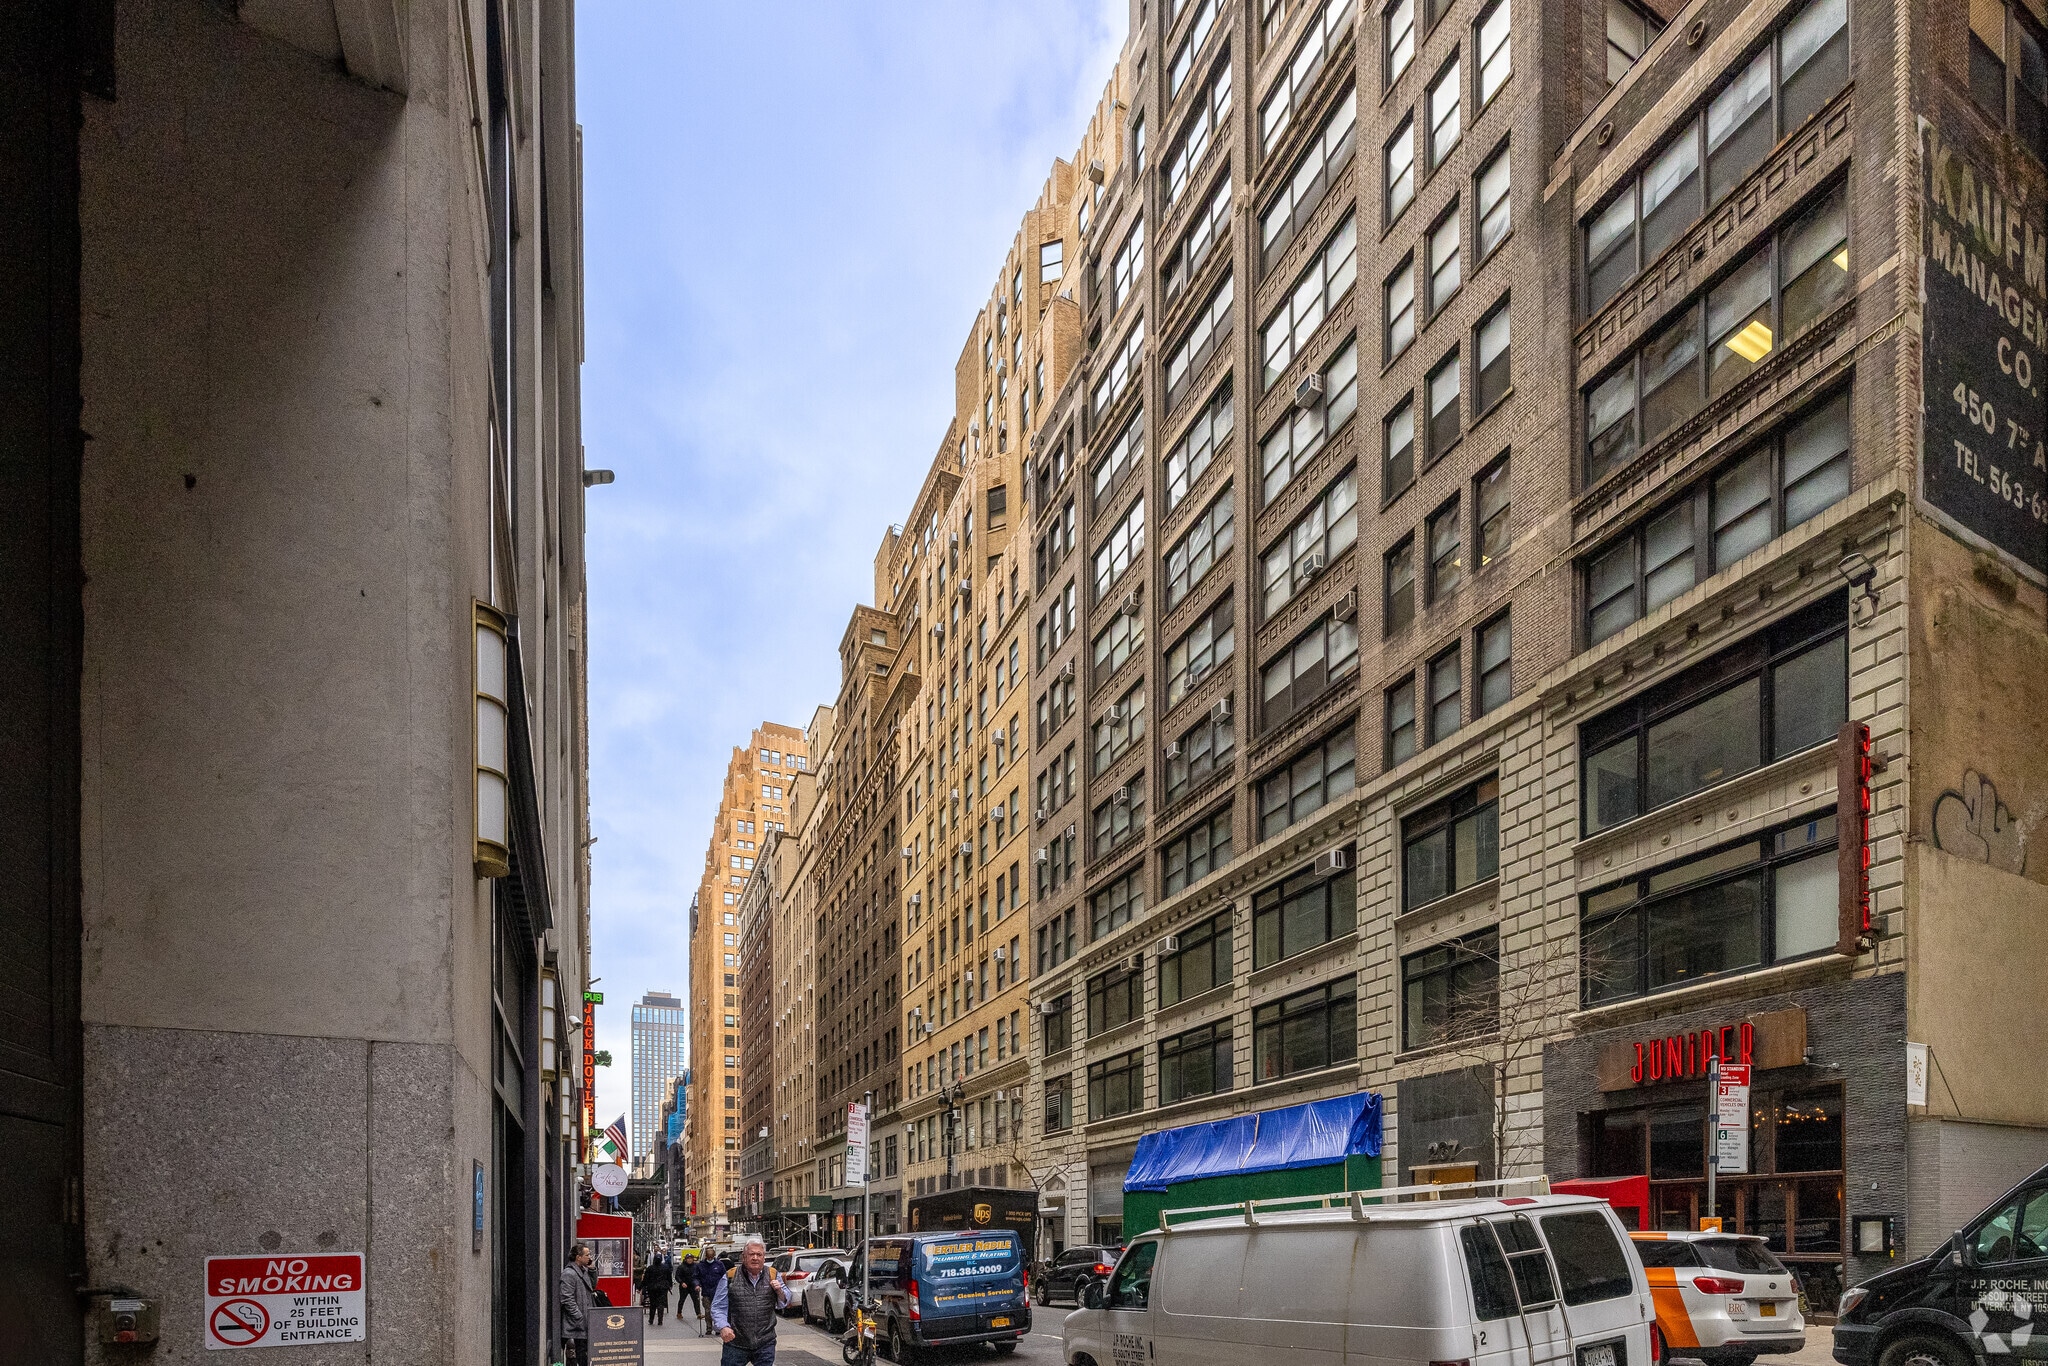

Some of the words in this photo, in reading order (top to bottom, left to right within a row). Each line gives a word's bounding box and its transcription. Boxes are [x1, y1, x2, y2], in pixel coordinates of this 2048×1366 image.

[1997, 336, 2038, 398] CO.
[1952, 381, 1996, 435] 450
[1953, 438, 1985, 485] TEL.
[583, 992, 603, 1003] PUB
[584, 1003, 594, 1050] JACK
[1721, 1086, 1727, 1095] 3
[849, 1104, 854, 1113] 3
[1720, 1131, 1726, 1139] 6
[848, 1146, 853, 1155] 6
[975, 1209, 990, 1221] ups
[932, 1254, 970, 1262] PLUMBING
[971, 1252, 978, 1260] &
[265, 1259, 309, 1276] NO
[218, 1274, 353, 1294] SMOKING
[1971, 1280, 1988, 1289] J.P.
[1990, 1280, 2031, 1291] ROCHE,
[293, 1295, 339, 1306] WITHIN
[957, 1291, 986, 1299] Cleaning
[1978, 1291, 1987, 1301] 55
[1988, 1291, 2014, 1301] SOUTH
[2016, 1292, 2048, 1303] STREET
[290, 1308, 305, 1318] 25
[310, 1307, 343, 1317] FEET
[1728, 1303, 1746, 1313] BRC
[2020, 1303, 2033, 1312] NY
[273, 1321, 292, 1330] OF
[297, 1317, 359, 1328] BUILDING
[281, 1329, 352, 1341] ENTRANCE
[1479, 1331, 1487, 1346] 2
